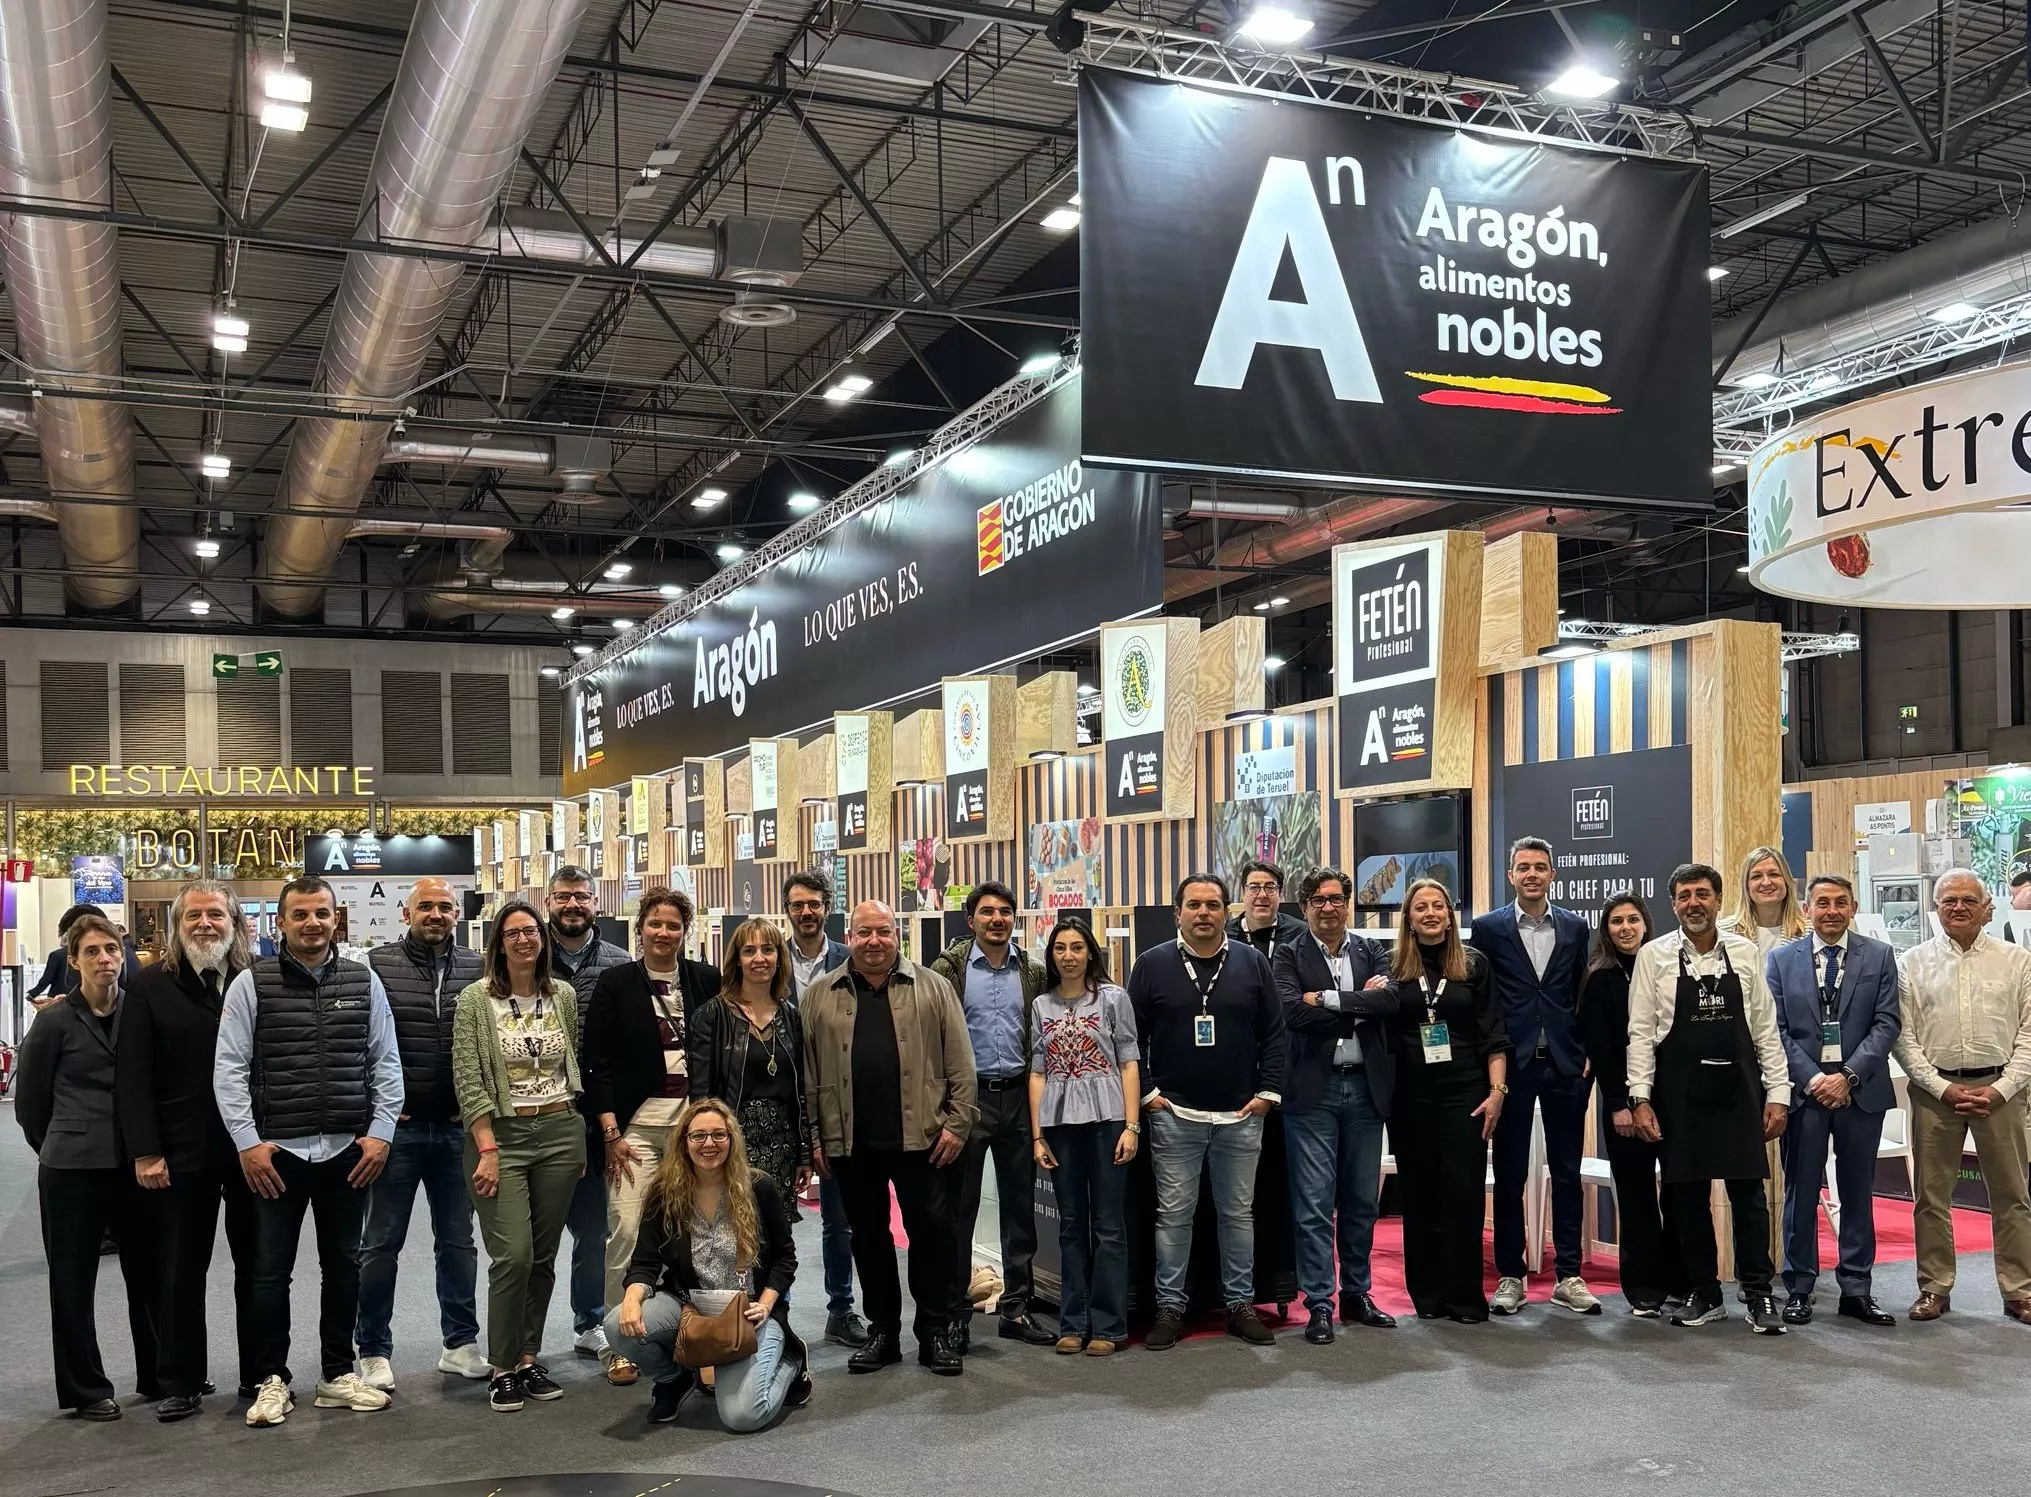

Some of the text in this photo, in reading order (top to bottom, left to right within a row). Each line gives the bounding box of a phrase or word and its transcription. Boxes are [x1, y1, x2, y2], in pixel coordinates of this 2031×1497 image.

[1416, 187, 1608, 269] Aragón,
[1419, 253, 1571, 307] alimentos
[1437, 306, 1603, 368] nobles
[1003, 459, 1082, 527] GOBIERNO
[1004, 524, 1023, 561] DE
[804, 561, 924, 647] LO QUE VES, ES.
[693, 605, 778, 717] Aragón
[616, 682, 675, 729] LO QUE VES, ES.
[1392, 704, 1426, 723] Aragón,
[1395, 731, 1424, 747] nobles
[70, 765, 376, 796] RESTAURANTE
[1256, 768, 1294, 783] Diputación
[1256, 781, 1289, 795] de Teruel
[1869, 814, 1896, 822] ALMAZARA
[136, 817, 312, 869] BOTÁN
[353, 843, 381, 853] Aragón,
[1557, 852, 1630, 867] FETÉN PROFESIONAL:
[1049, 893, 1083, 908] BOCADOS
[1545, 880, 1564, 900] RO
[1569, 880, 1598, 900] CHEF
[1640, 878, 1655, 899] TU
